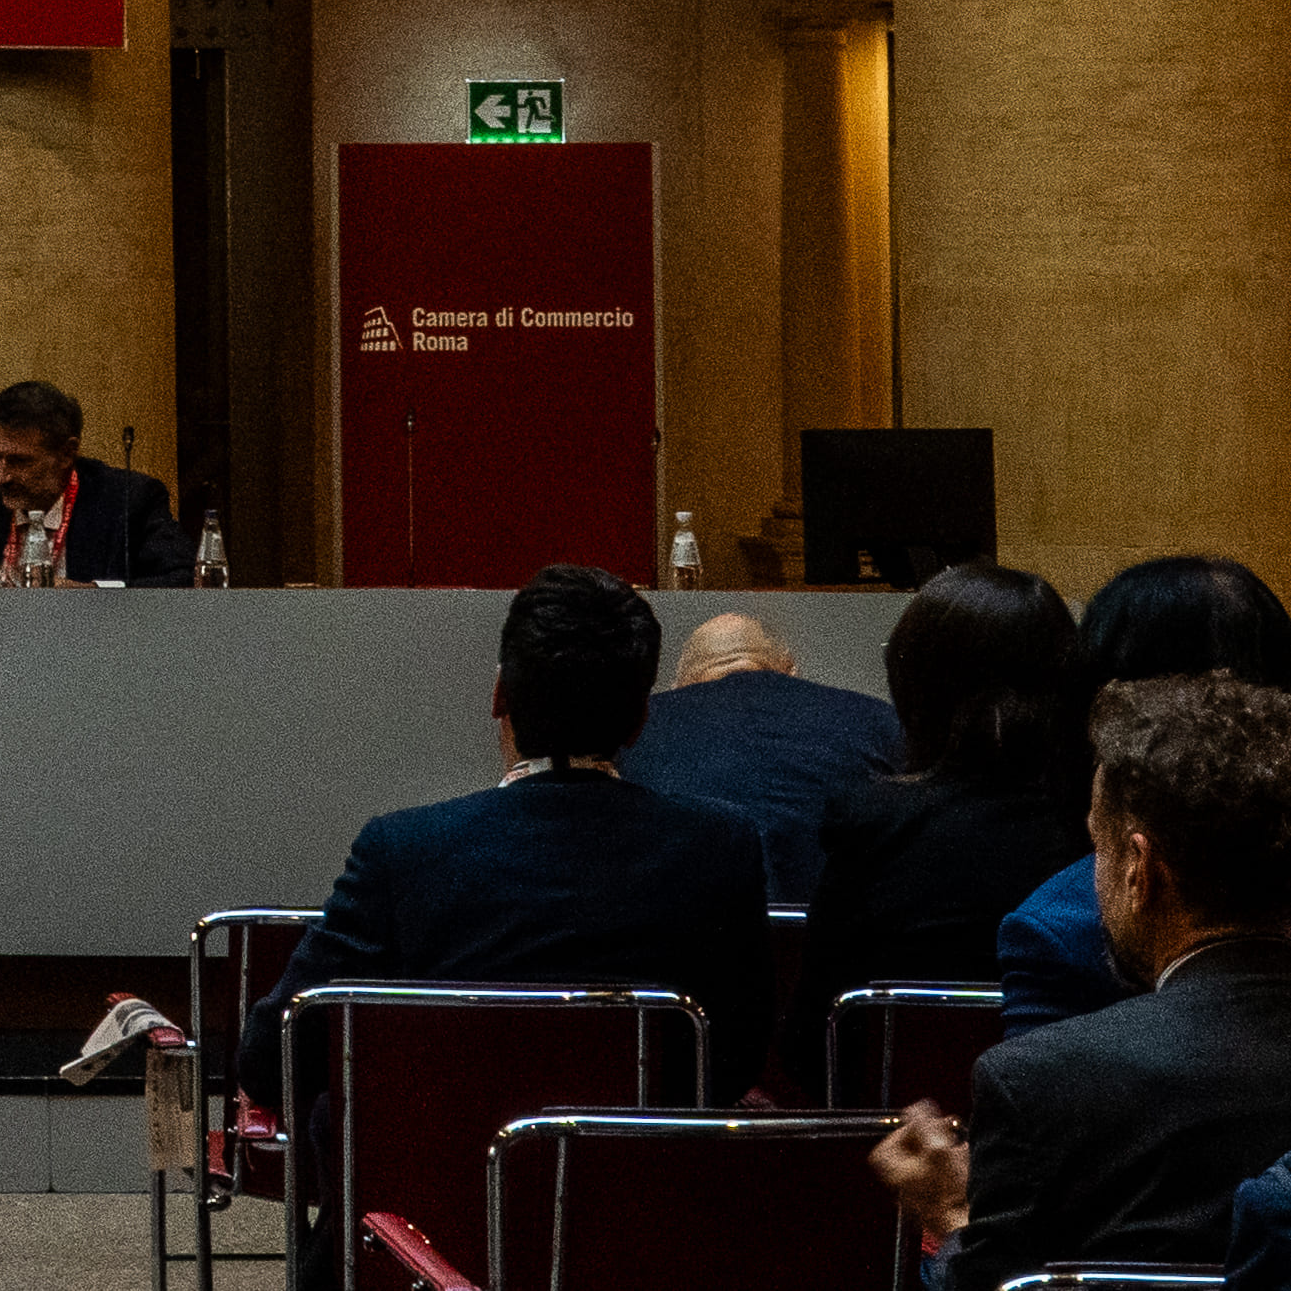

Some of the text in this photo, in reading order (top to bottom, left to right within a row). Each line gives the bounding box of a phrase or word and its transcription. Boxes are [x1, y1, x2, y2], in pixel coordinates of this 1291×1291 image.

[412, 307, 633, 327] Camera di Commercio
[413, 331, 468, 351] Roma
